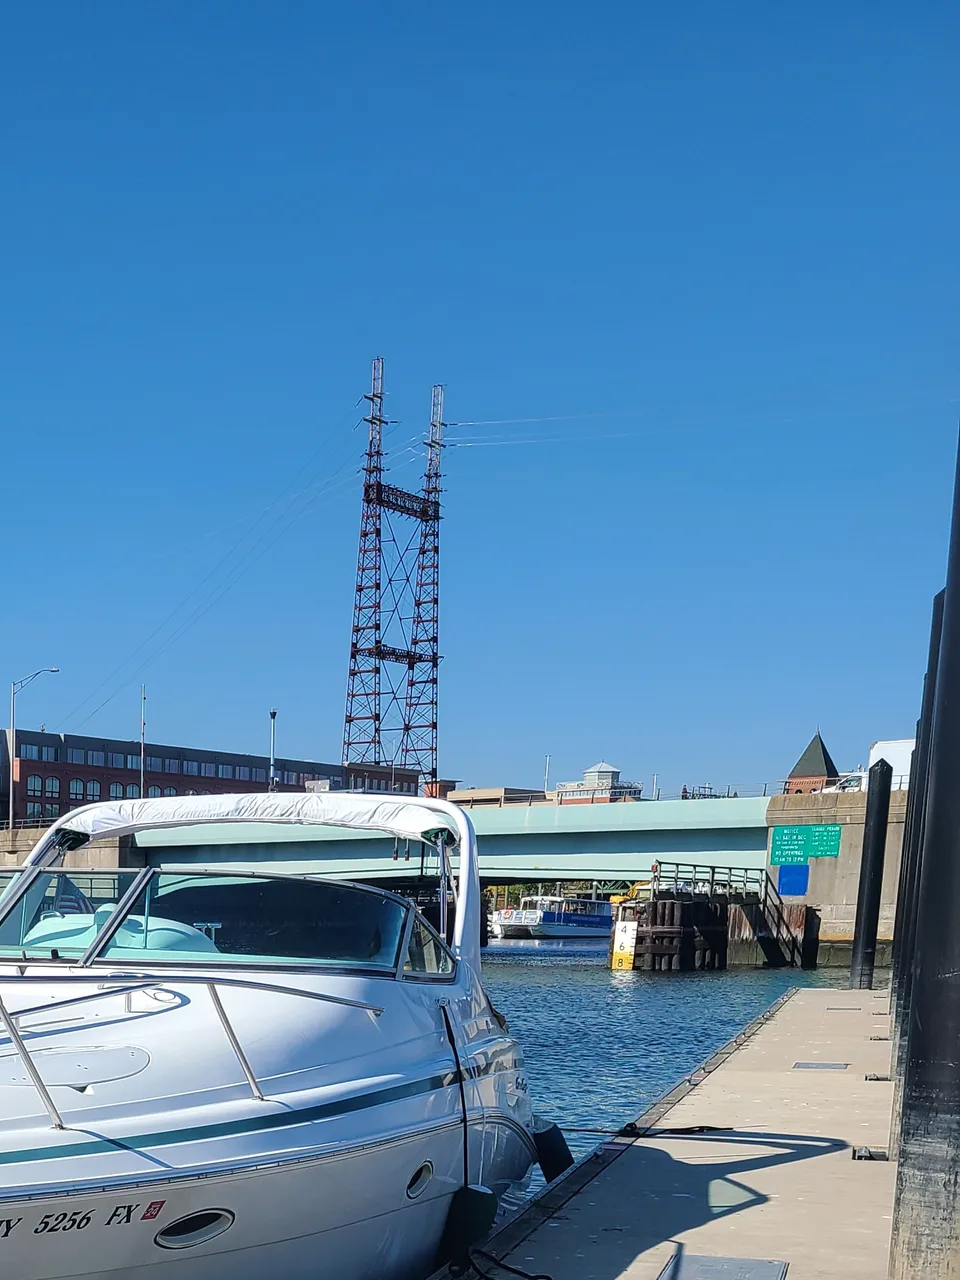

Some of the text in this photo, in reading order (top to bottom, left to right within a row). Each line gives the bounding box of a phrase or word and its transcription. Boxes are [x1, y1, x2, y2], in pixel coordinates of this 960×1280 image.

[621, 925, 627, 934] 4
[619, 942, 625, 951] 6
[618, 958, 623, 967] 8
[33, 1208, 96, 1235] 5256
[104, 1203, 141, 1226] FX
